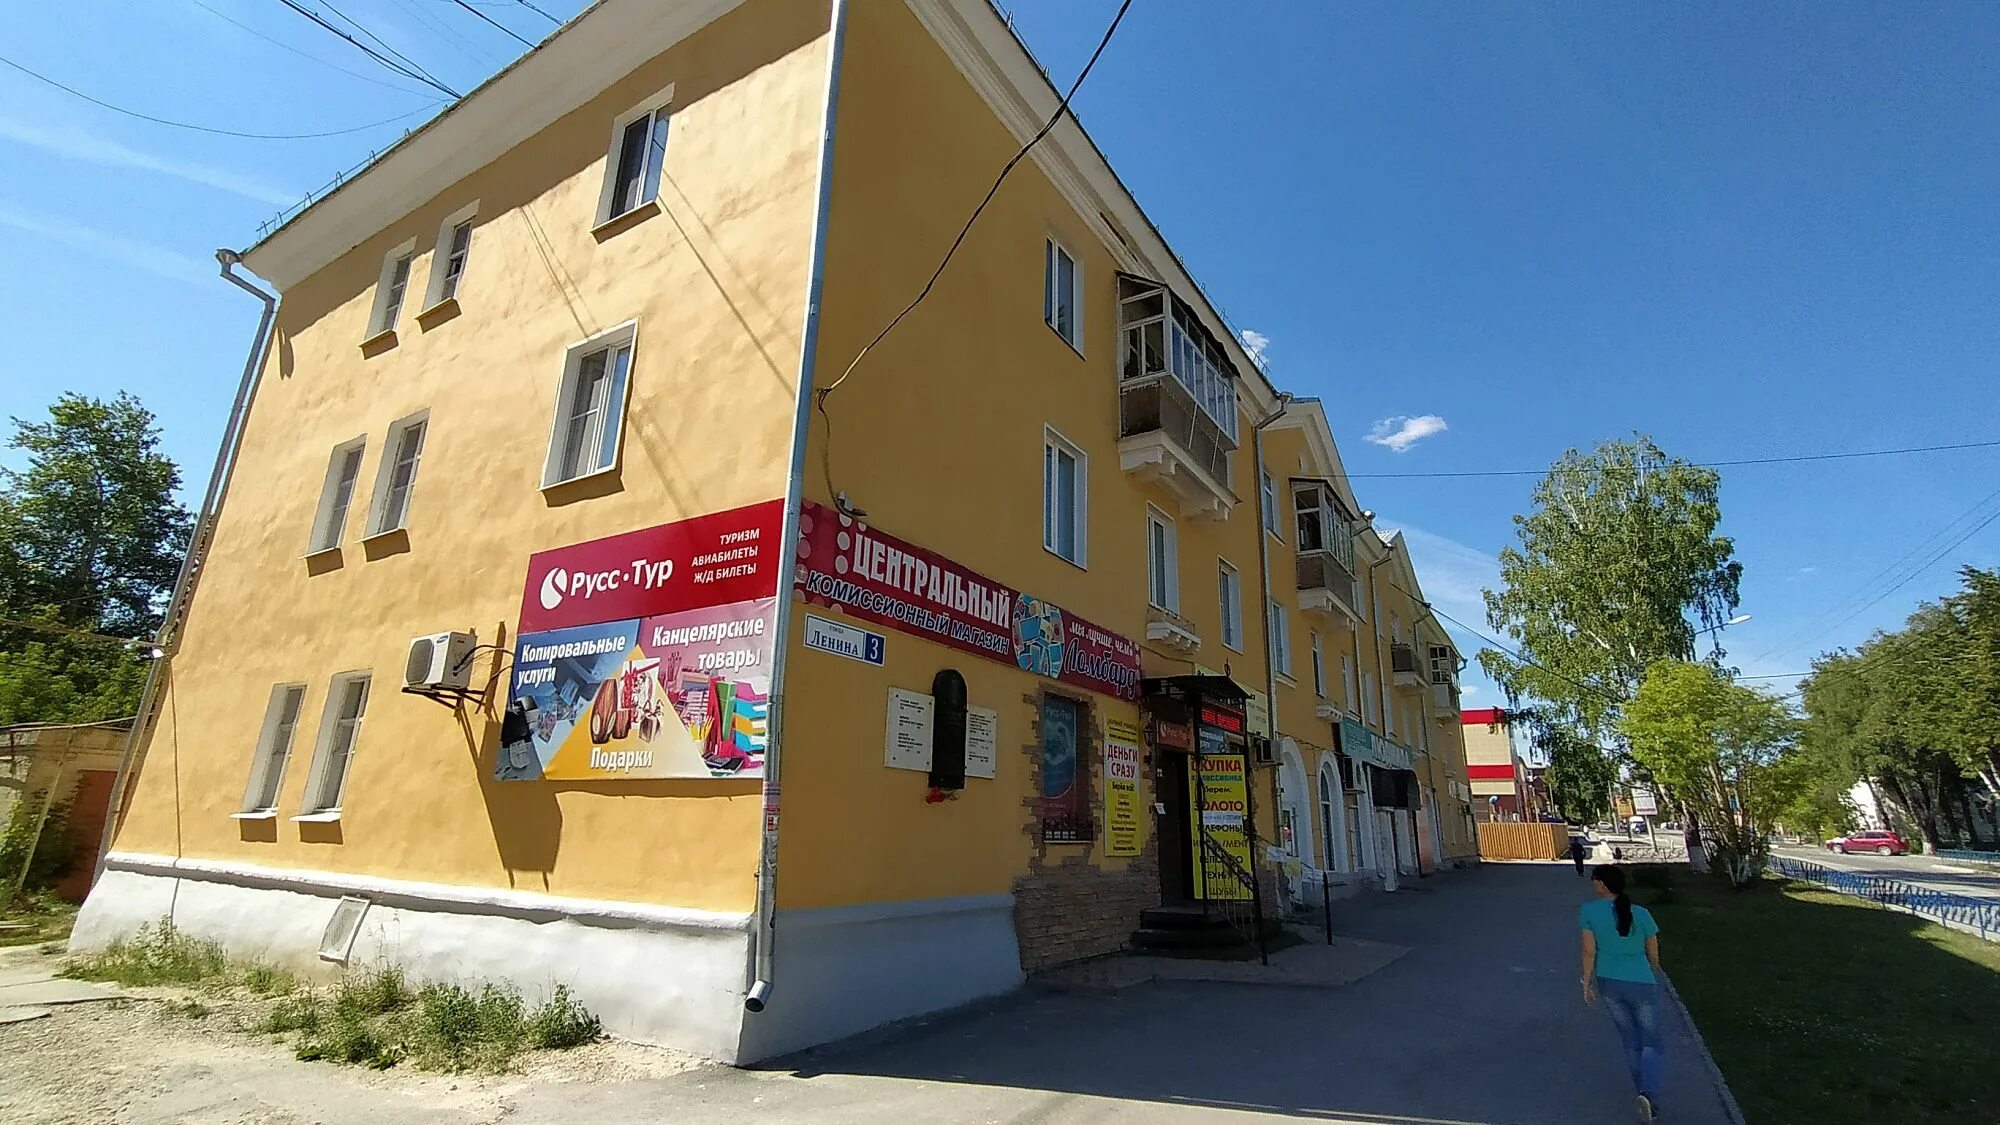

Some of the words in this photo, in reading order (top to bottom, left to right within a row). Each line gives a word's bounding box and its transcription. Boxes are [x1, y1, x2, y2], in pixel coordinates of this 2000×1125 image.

[720, 528, 760, 546] ТУРИЗМ
[691, 546, 759, 567] АВИАБИЛЕТЫ
[693, 571, 714, 584] Ж/Д
[715, 563, 757, 580] БИЛЕТЫ
[853, 532, 1011, 630] ЦЕНТРАЛЬНЫЙ
[806, 571, 950, 634] КОМИССИОННЫЙ
[951, 620, 1010, 656] МАГАЗИН
[652, 617, 764, 648] Канцелярские
[1069, 621, 1085, 638] мы
[521, 635, 626, 664] Копировальные
[870, 638, 879, 660] 3
[698, 650, 761, 674] товары
[1064, 638, 1137, 700] Ломбард
[517, 666, 556, 690] услуги
[590, 747, 654, 774] Подарки
[1107, 744, 1138, 762] ДЕНЬГИ
[1111, 762, 1135, 778] СРАЗУ
